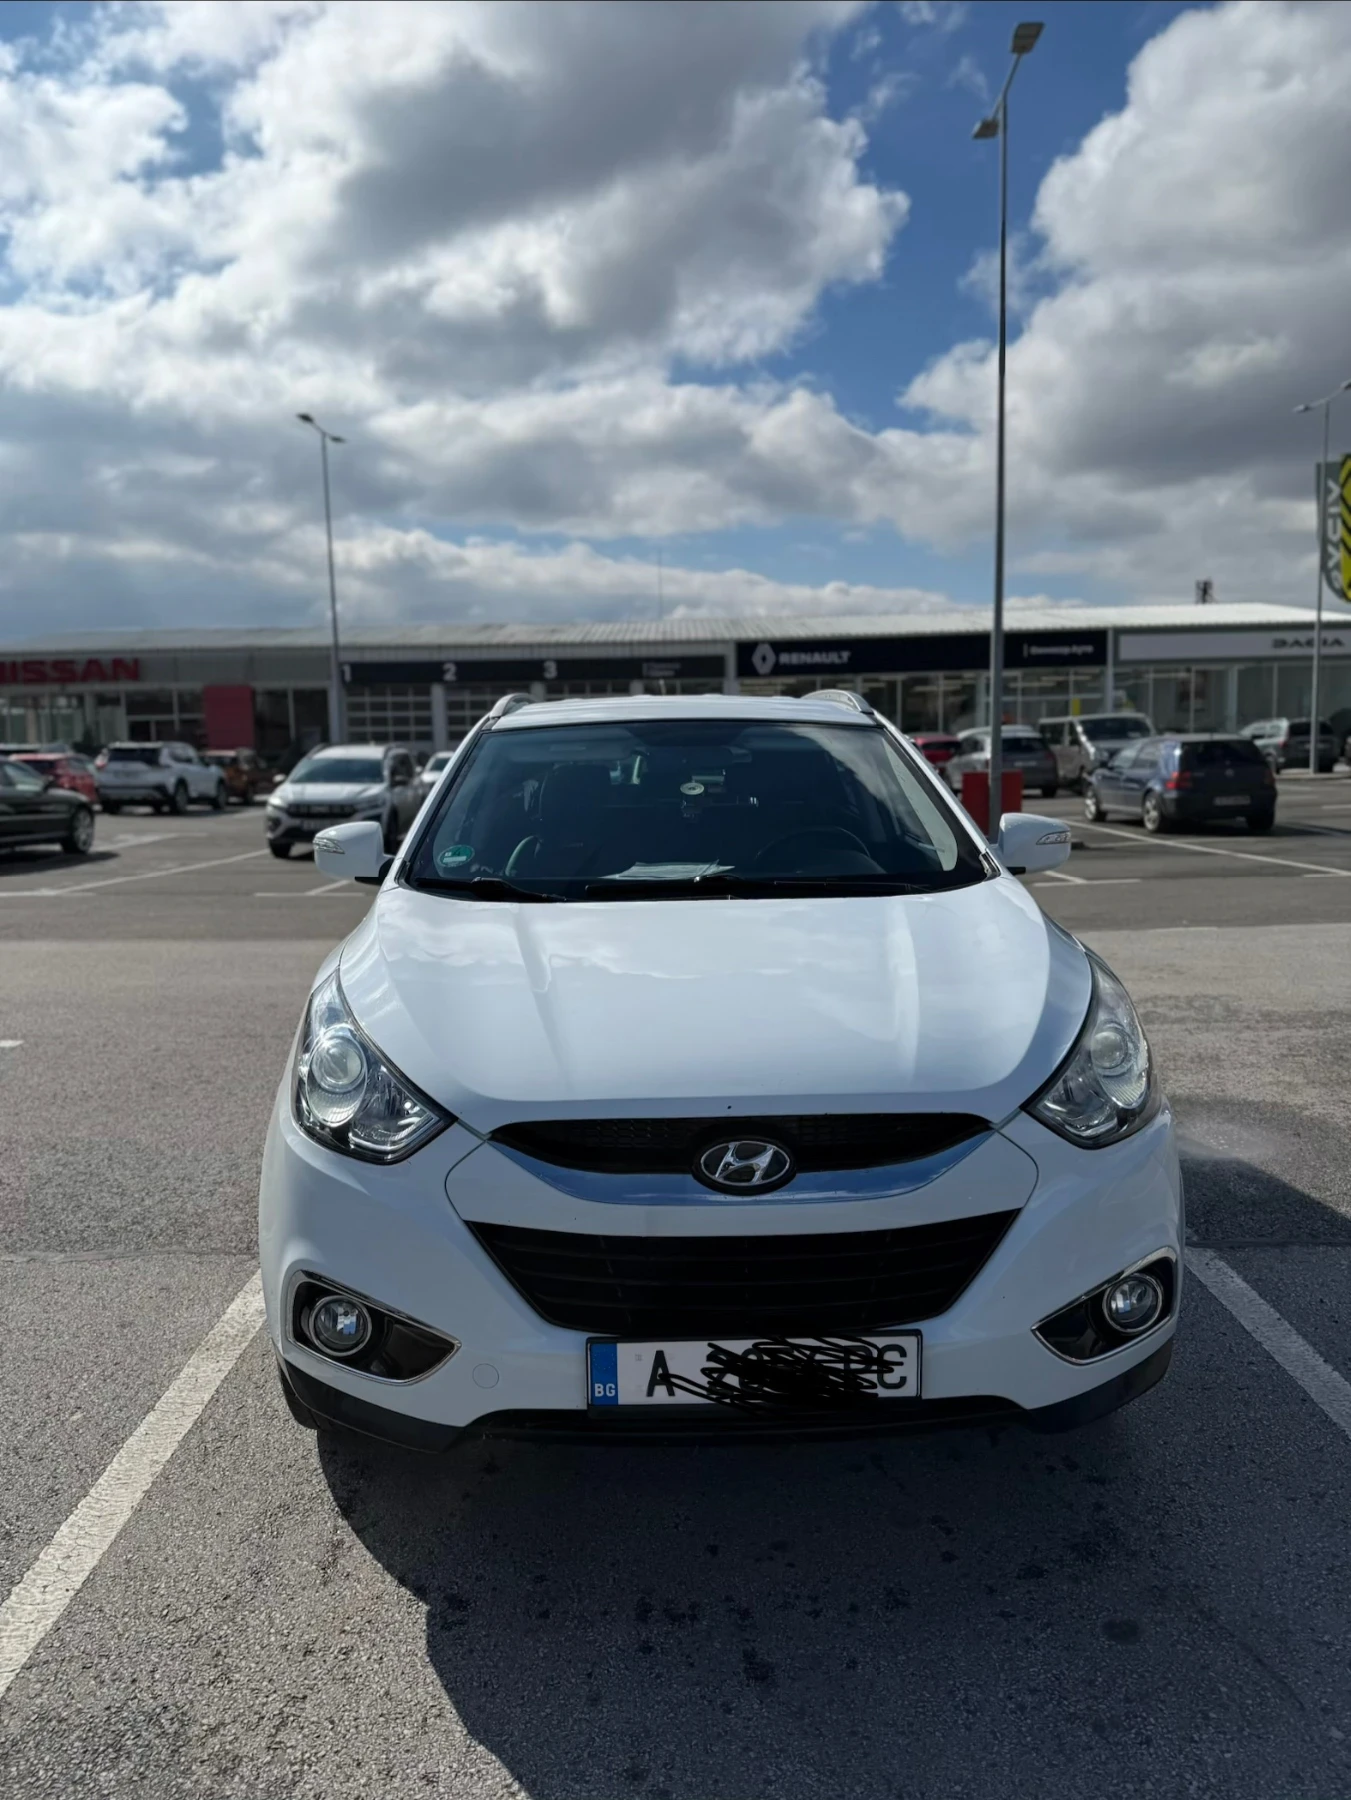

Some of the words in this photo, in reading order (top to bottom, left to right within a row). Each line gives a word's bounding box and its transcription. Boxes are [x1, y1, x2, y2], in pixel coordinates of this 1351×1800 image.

[778, 650, 852, 665] RENAULT
[0, 657, 140, 684] ISSAN
[341, 662, 353, 682] 1
[442, 661, 457, 682] 2
[544, 660, 558, 680] 3
[594, 1383, 616, 1398] BG
[646, 1350, 676, 1397] A
